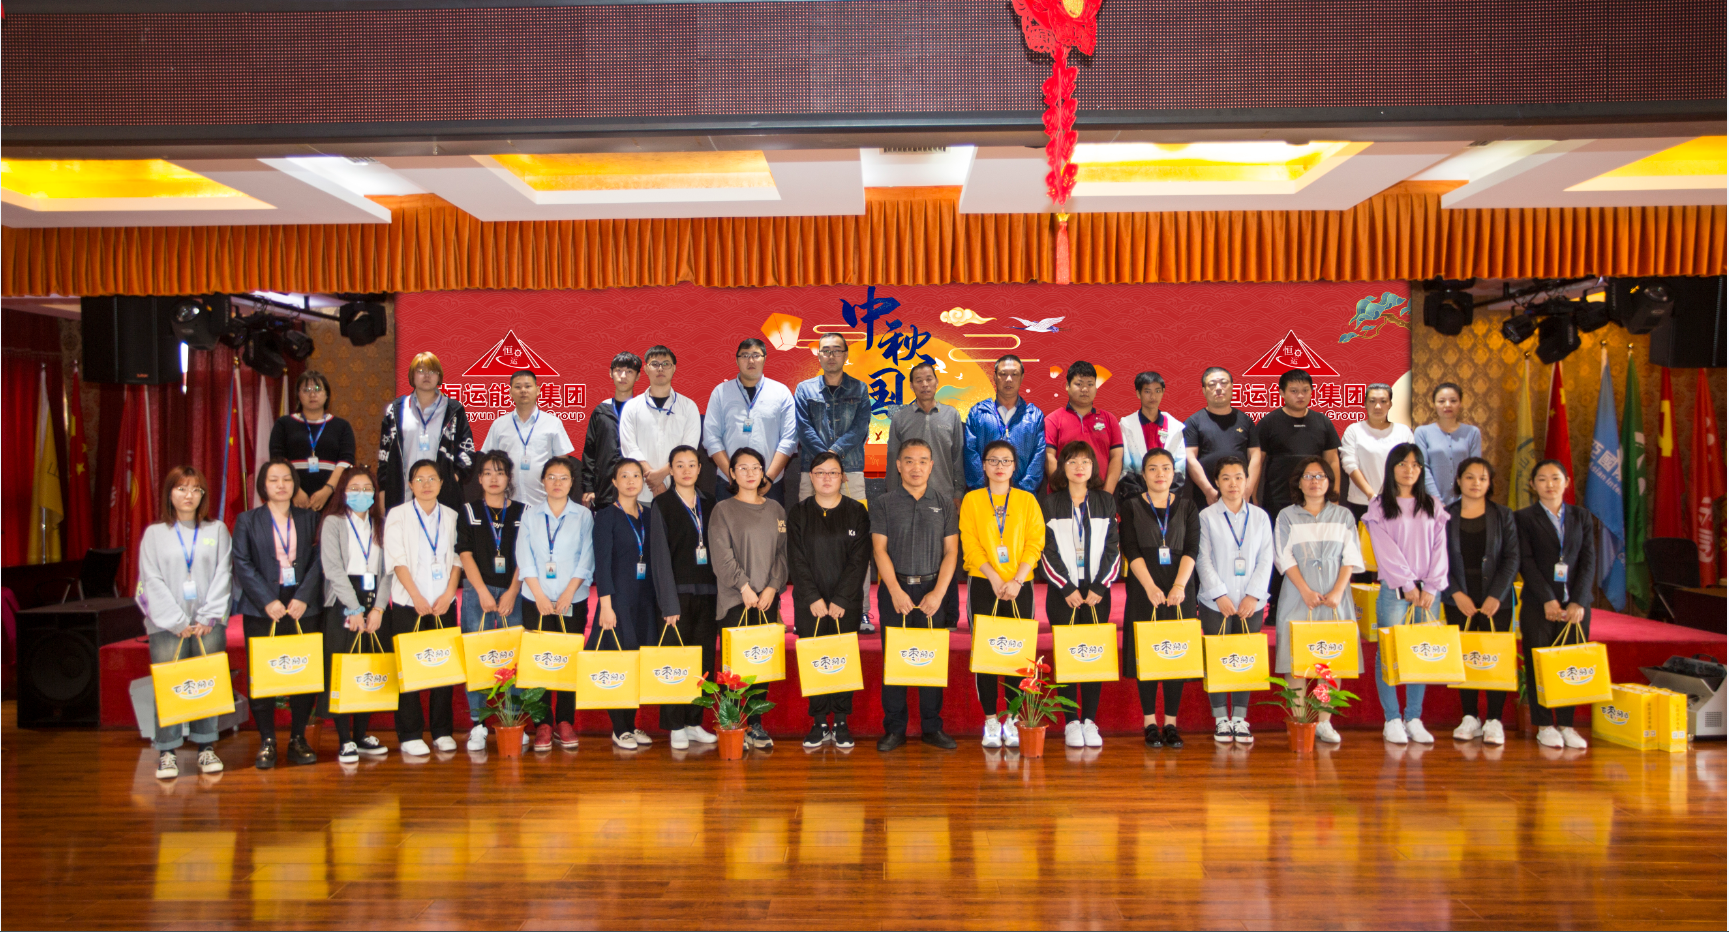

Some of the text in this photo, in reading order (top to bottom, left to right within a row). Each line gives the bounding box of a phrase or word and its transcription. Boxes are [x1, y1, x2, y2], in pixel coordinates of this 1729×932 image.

[438, 382, 586, 407] 恒运能集团
[1325, 410, 1365, 422] Group
